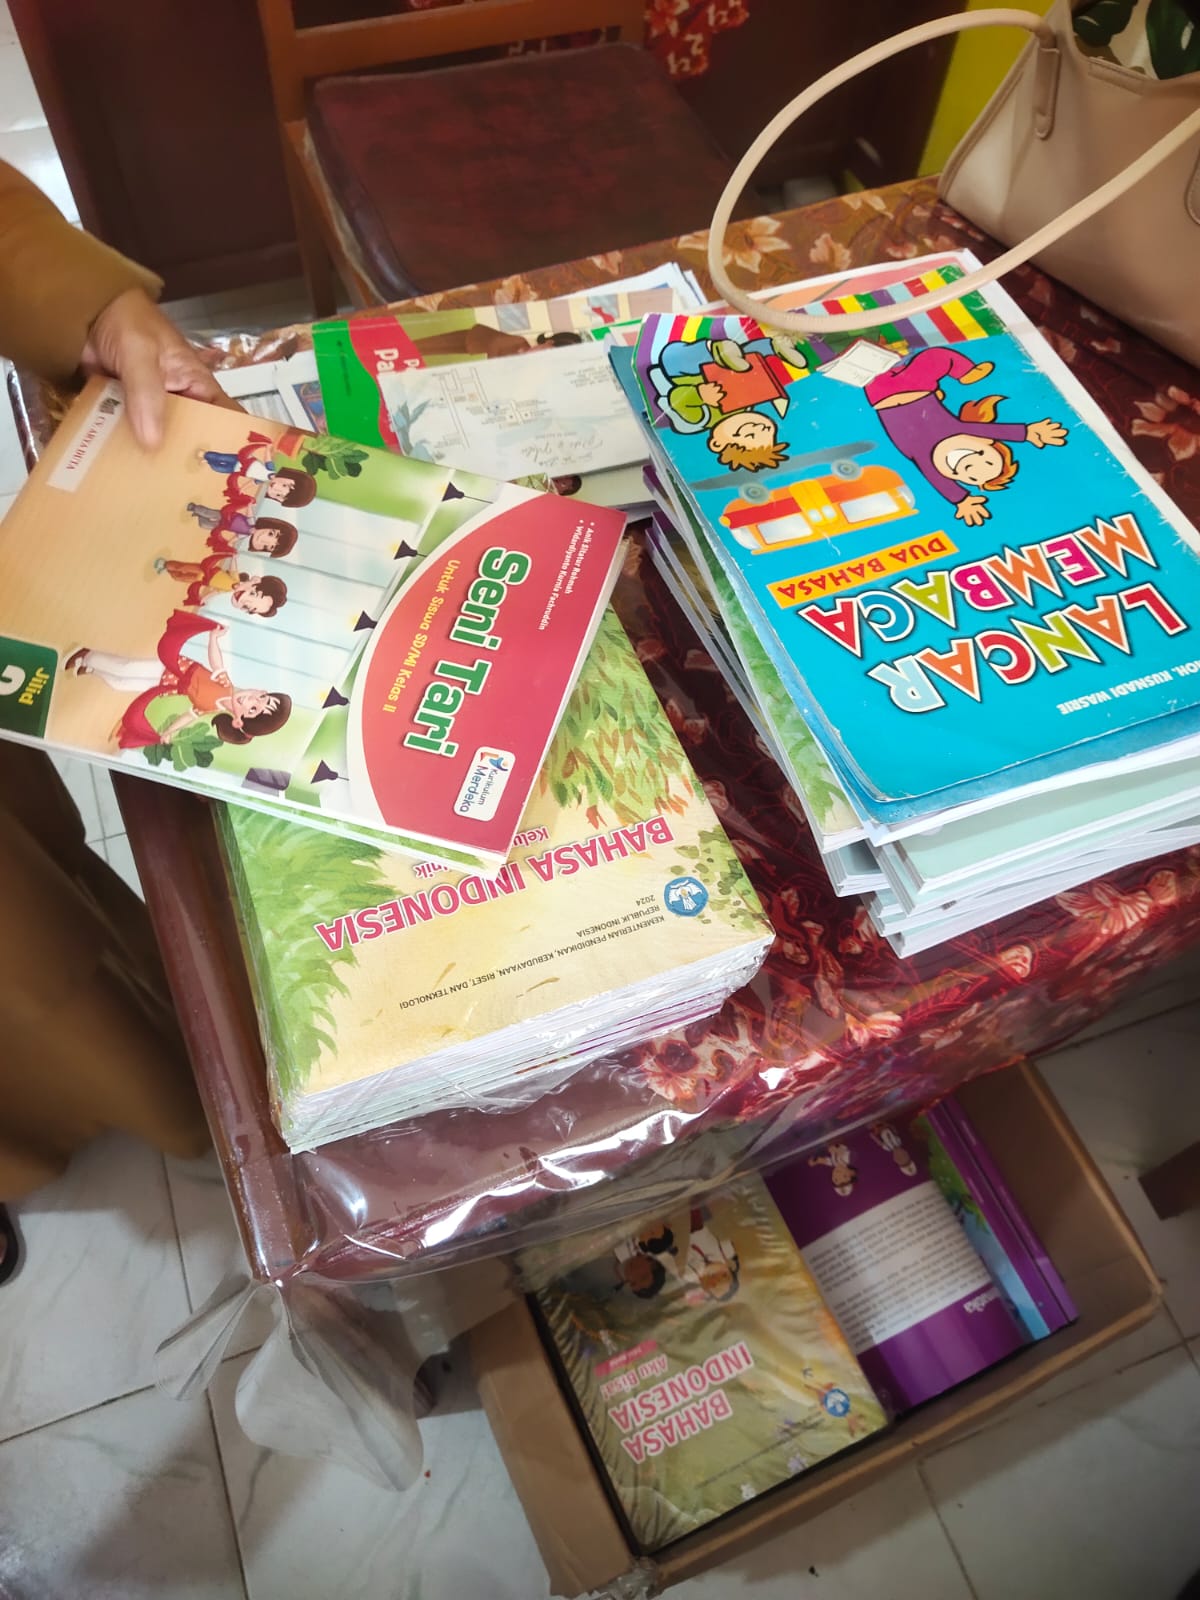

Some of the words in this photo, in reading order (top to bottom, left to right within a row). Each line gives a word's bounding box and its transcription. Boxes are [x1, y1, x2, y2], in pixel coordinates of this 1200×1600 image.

[889, 538, 947, 563] DUA
[436, 558, 461, 594] Untuk
[777, 556, 886, 599] BAHASA
[798, 512, 1159, 658] MEMBACA
[419, 595, 444, 631] Siswa
[450, 547, 531, 650] Seni
[403, 633, 428, 668] SD/MI
[868, 583, 1189, 713] LANCAR
[17, 667, 52, 706] Jilid
[390, 670, 412, 702] Kelas
[1109, 670, 1173, 698] KUSNADI
[404, 659, 492, 758] Tari
[1056, 691, 1112, 715] WASRIE
[459, 765, 488, 813] Merdeka
[477, 768, 498, 805] Kurikulum
[529, 815, 674, 883] BAHASA
[315, 861, 525, 951] INDONESIA
[620, 904, 661, 923] REPUBLIK
[635, 893, 656, 906] 2024
[554, 932, 607, 957] PENDIDIKAN,
[575, 916, 620, 938] INDONESIA
[608, 914, 665, 940] KEMENTERIAN
[496, 951, 555, 977] KEBUDAYAAN,
[399, 986, 449, 1010] TEKNOLOGI
[447, 979, 469, 993] DAN
[636, 1354, 668, 1380] Aku
[609, 1341, 754, 1432] INDONESIA
[621, 1389, 732, 1464] BAHASA
